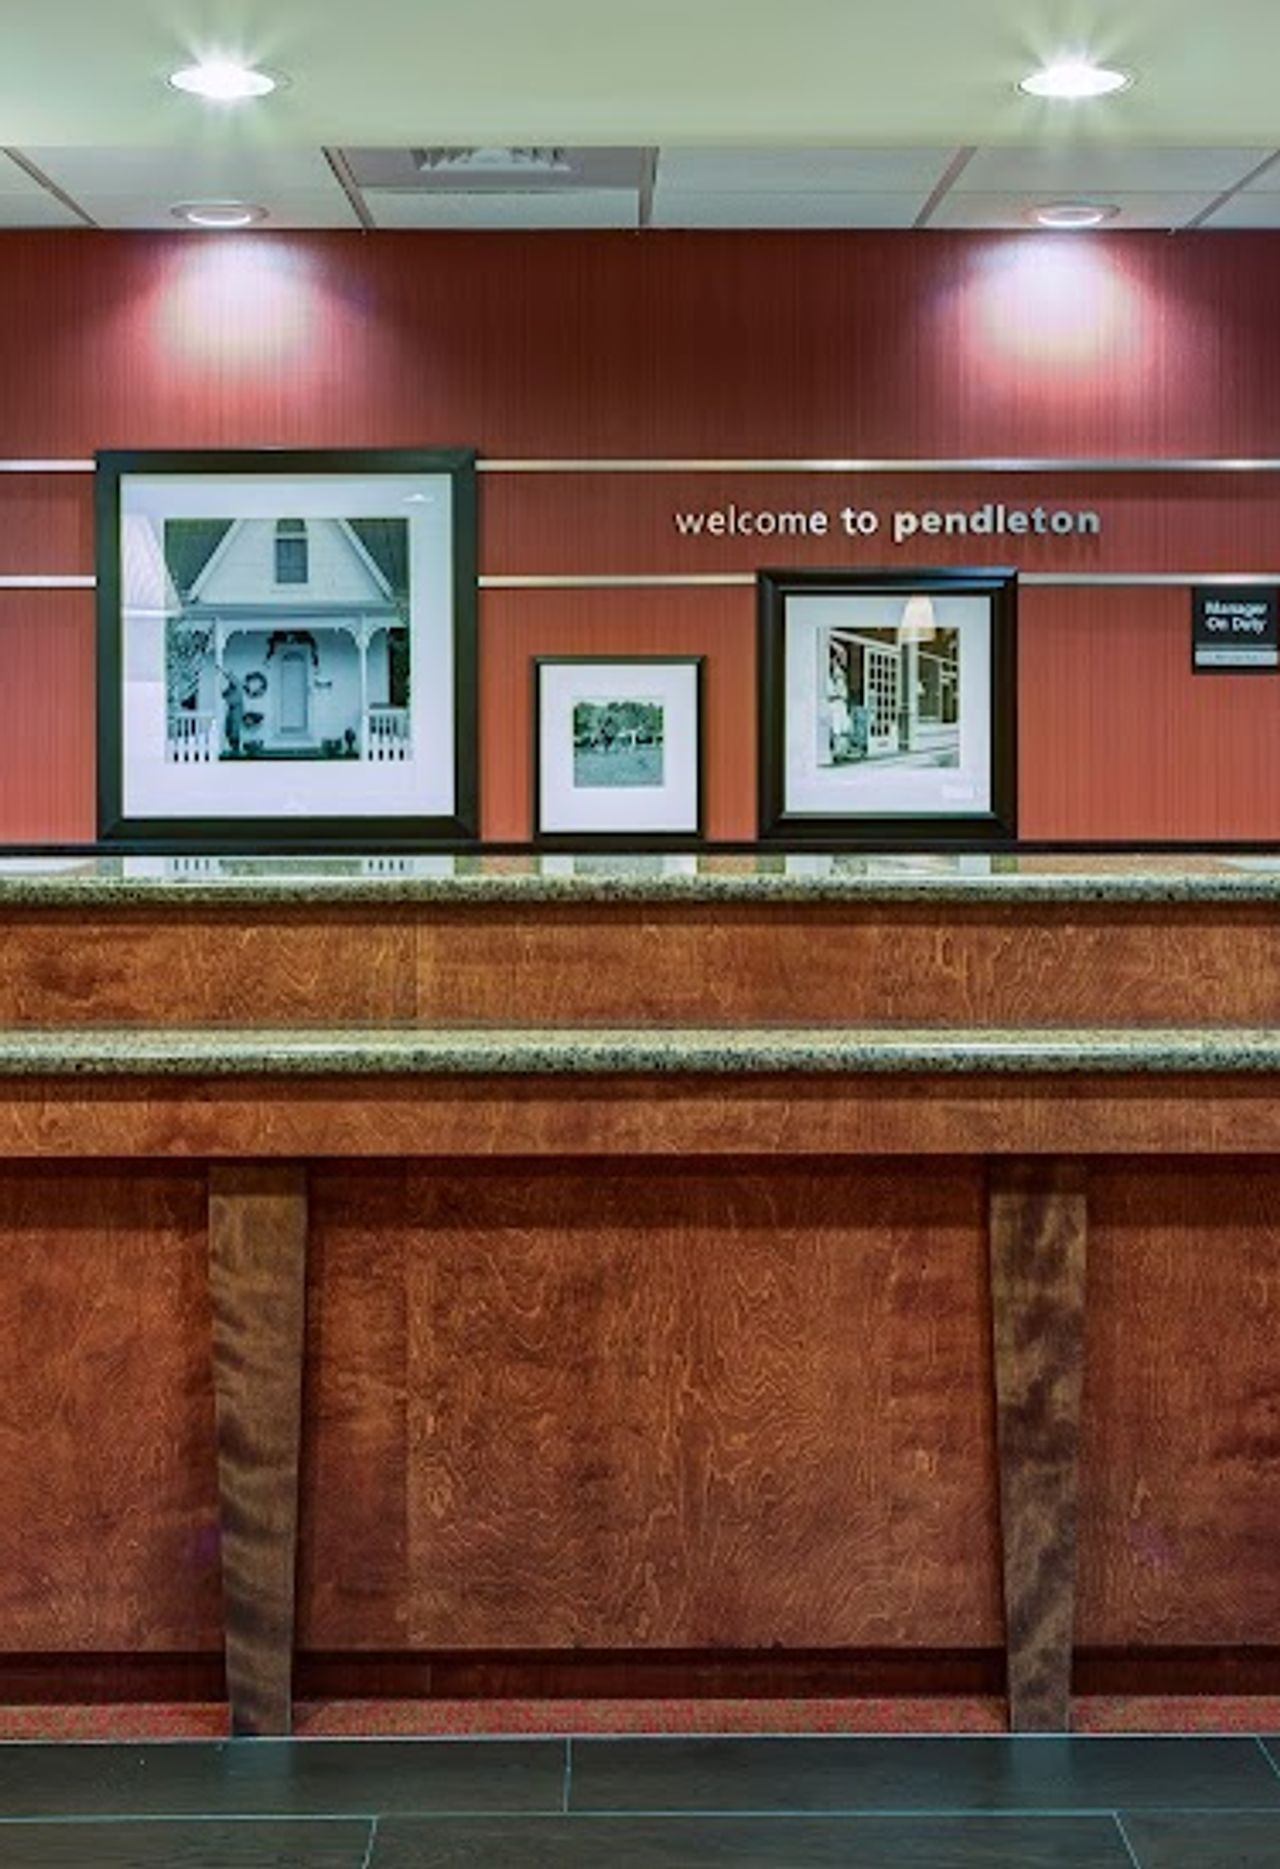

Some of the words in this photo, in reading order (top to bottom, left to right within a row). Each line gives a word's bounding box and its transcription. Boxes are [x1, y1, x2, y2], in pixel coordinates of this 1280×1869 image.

[675, 505, 829, 536] welcome
[841, 507, 879, 536] to
[894, 504, 1100, 543] pendleton
